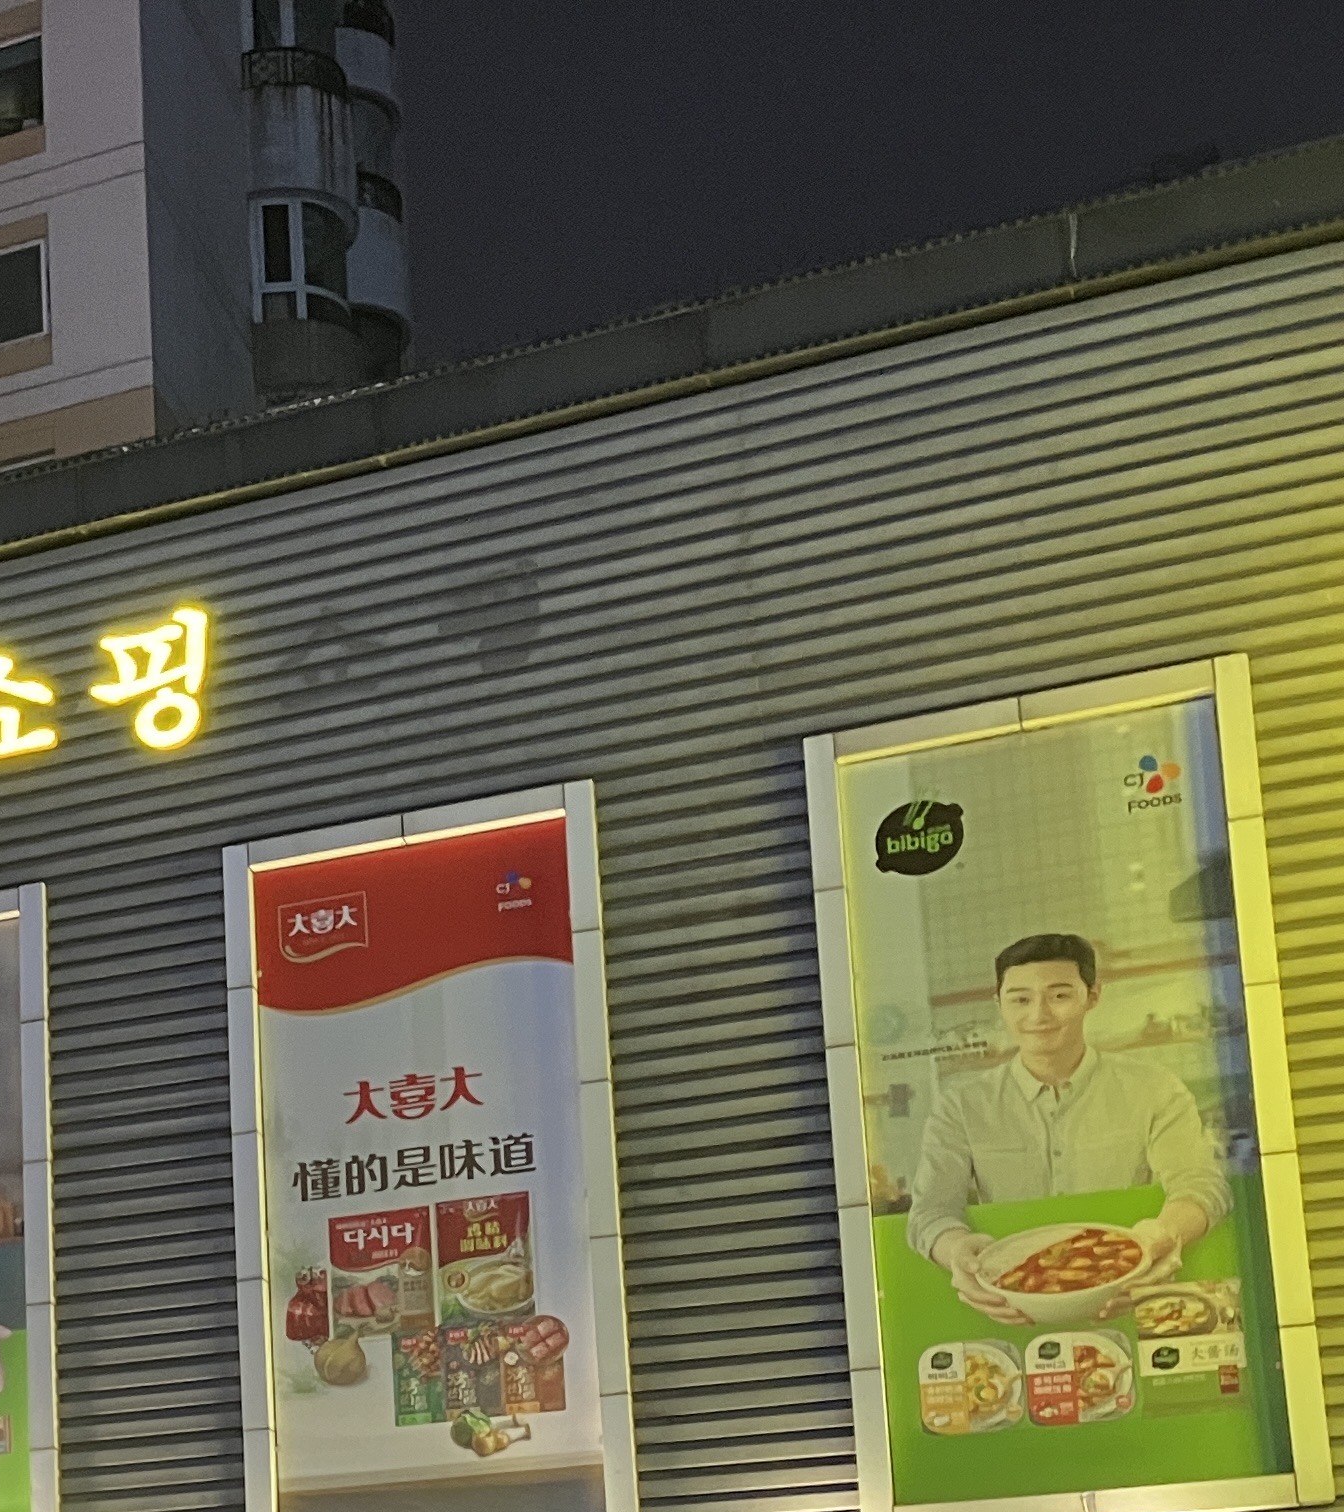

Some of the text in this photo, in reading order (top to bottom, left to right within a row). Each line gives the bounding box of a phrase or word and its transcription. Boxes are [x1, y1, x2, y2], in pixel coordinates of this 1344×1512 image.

[1123, 772, 1145, 788] CJ
[1127, 793, 1183, 814] FOODS
[886, 829, 955, 855] bibigo
[287, 904, 358, 937] 大喜大
[343, 1065, 485, 1124] 大喜大
[291, 1131, 538, 1203] 懂的是味道
[342, 1222, 416, 1250] 다시다
